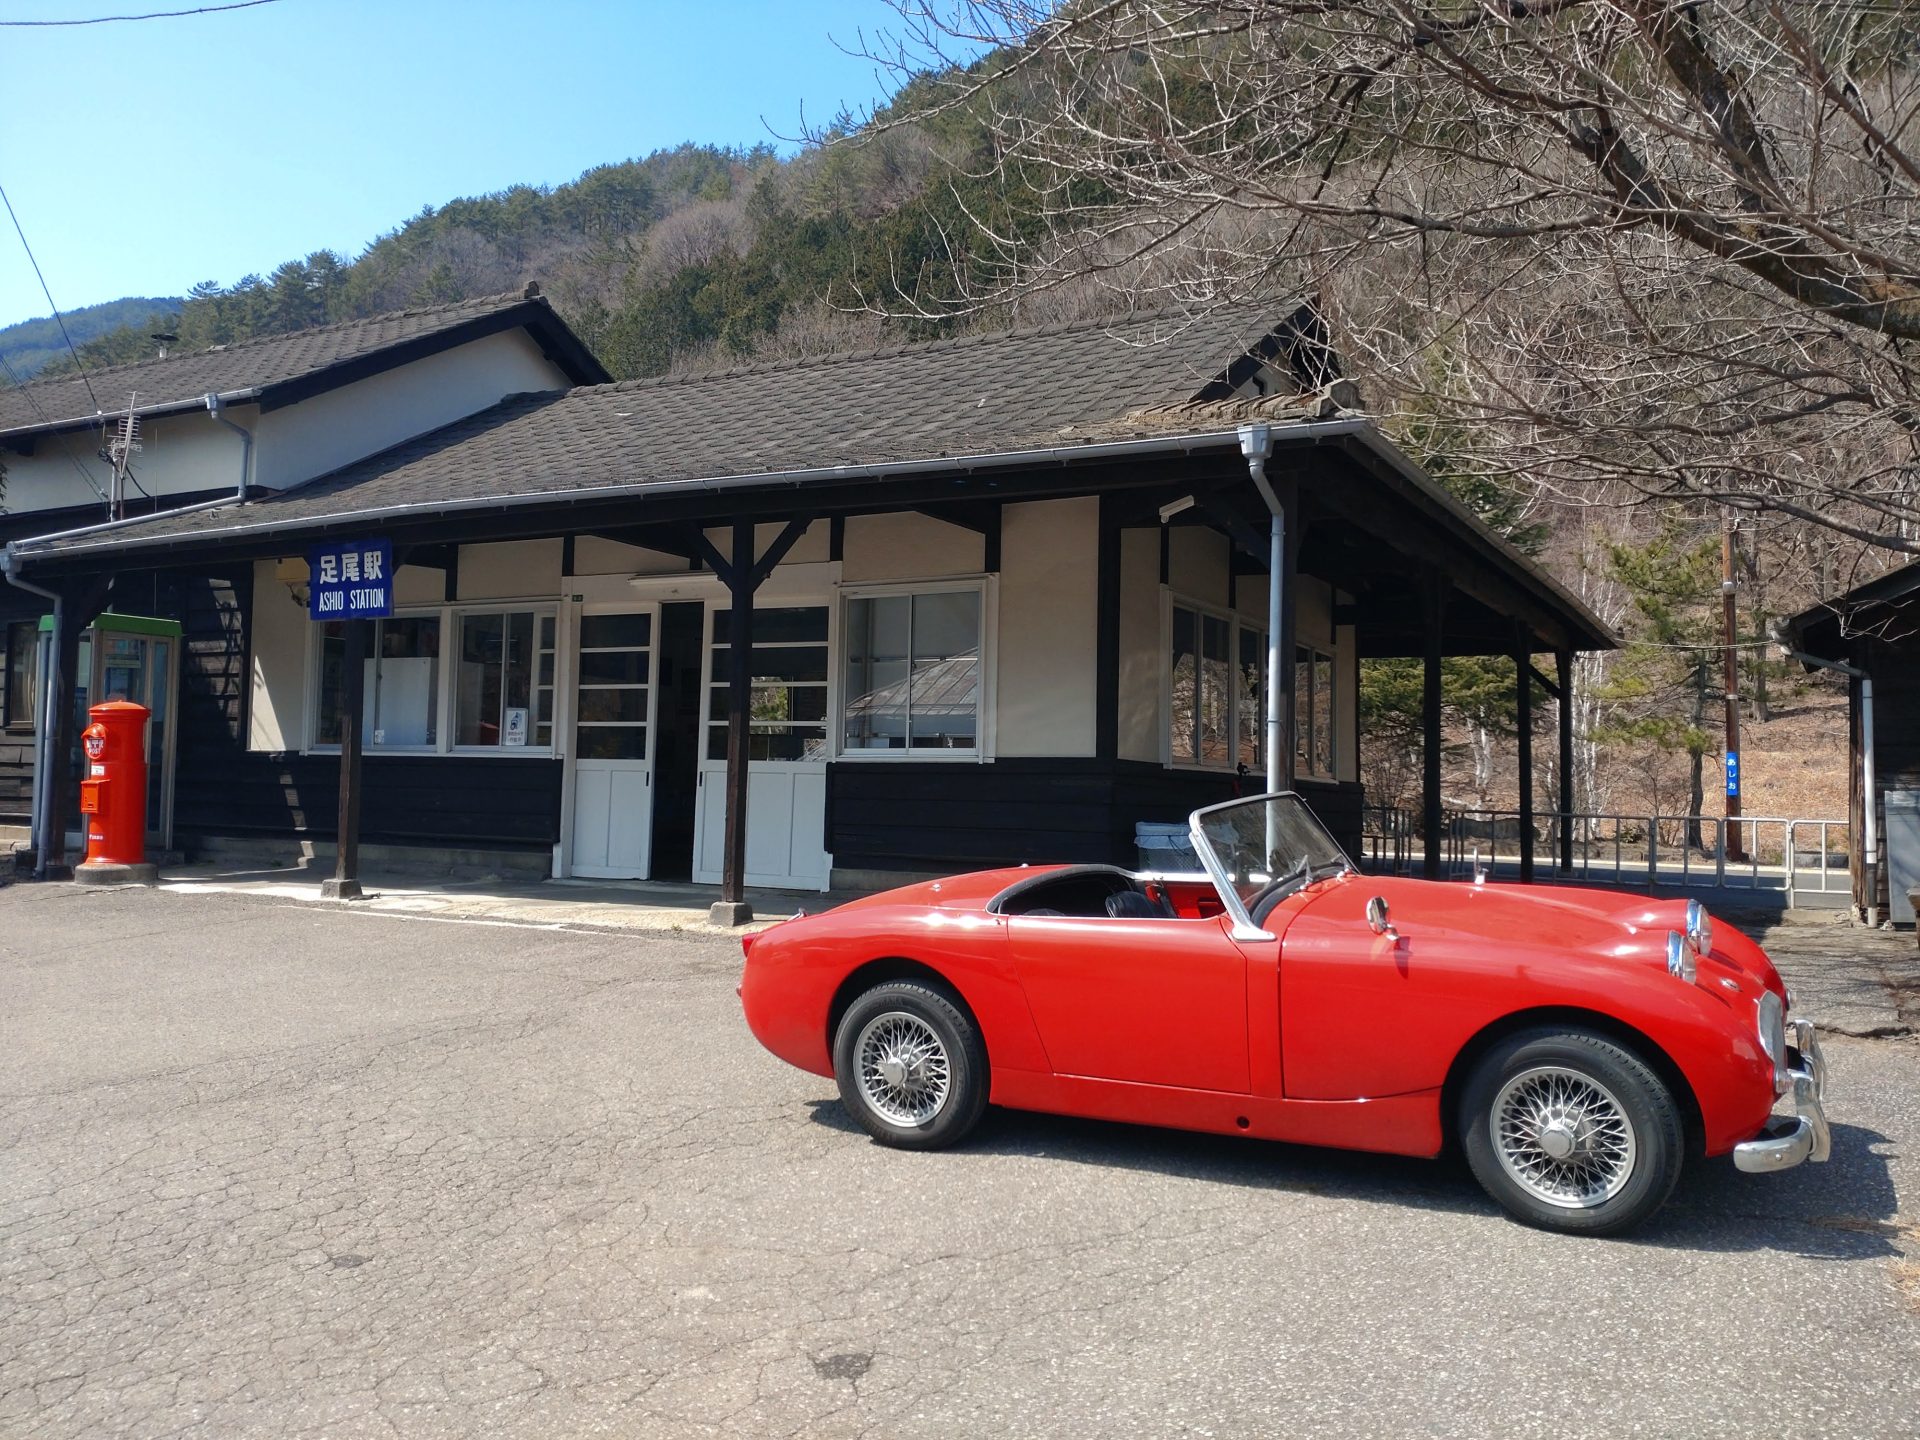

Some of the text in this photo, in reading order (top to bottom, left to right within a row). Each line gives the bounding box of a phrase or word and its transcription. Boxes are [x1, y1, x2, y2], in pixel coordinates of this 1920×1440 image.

[320, 551, 382, 584] 足尾駅
[318, 588, 384, 612] ASHIO STATION
[1727, 758, 1736, 790] あしお
